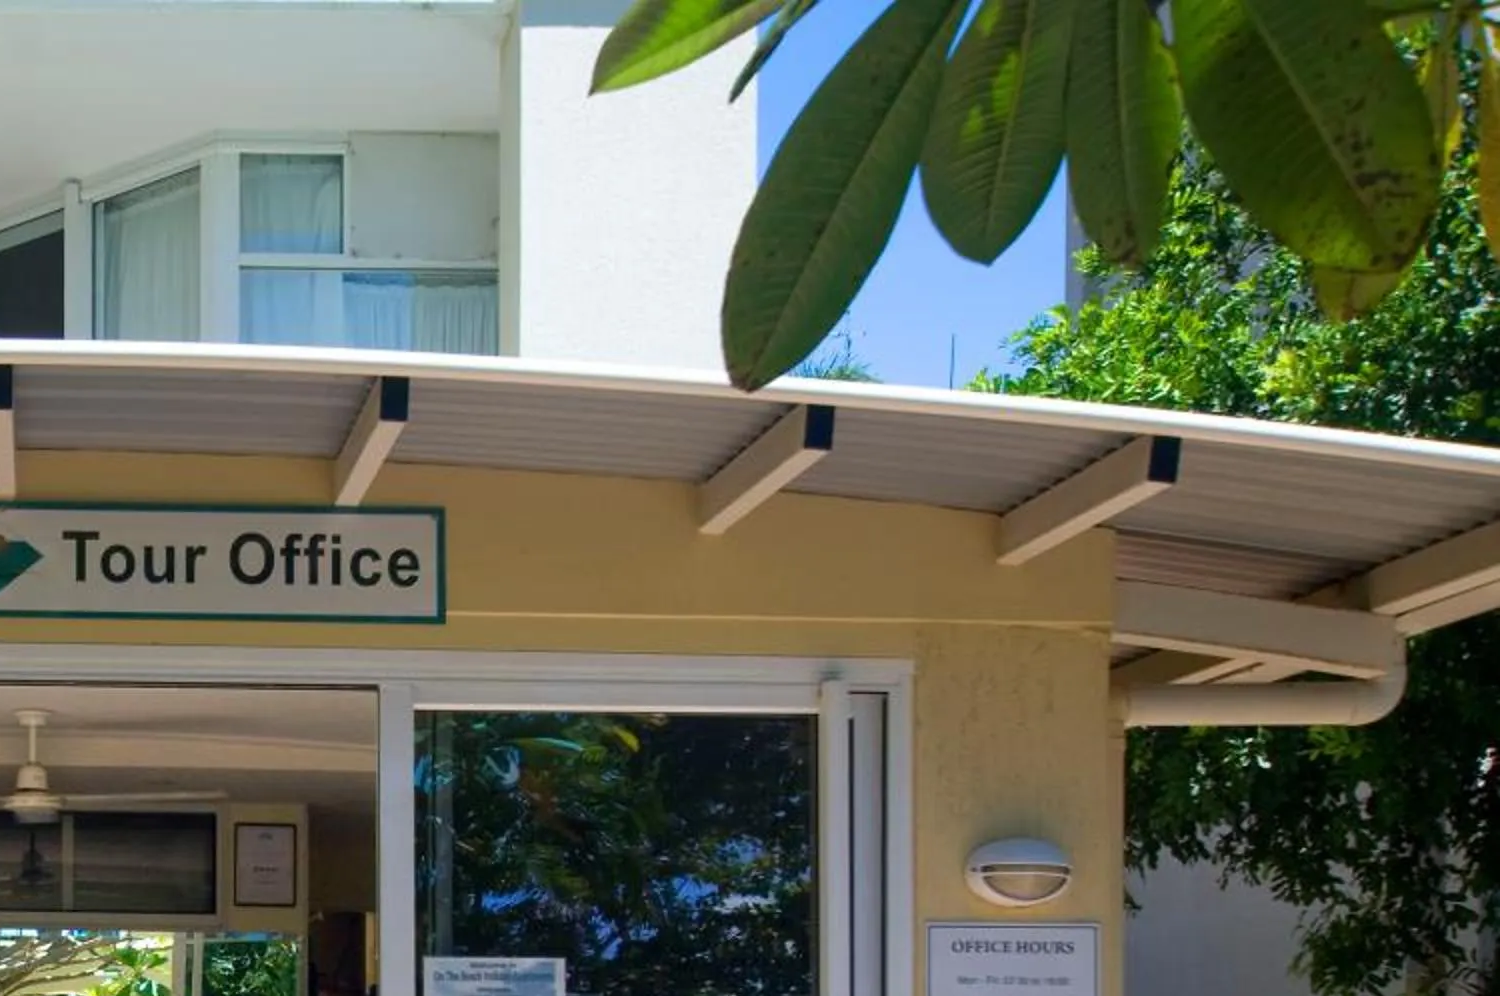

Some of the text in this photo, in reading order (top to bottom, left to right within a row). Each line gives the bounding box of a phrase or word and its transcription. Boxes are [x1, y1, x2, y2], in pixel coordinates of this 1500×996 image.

[63, 528, 206, 584] Tour
[228, 529, 422, 589] Office
[951, 939, 1076, 956] OFFICE HOURS
